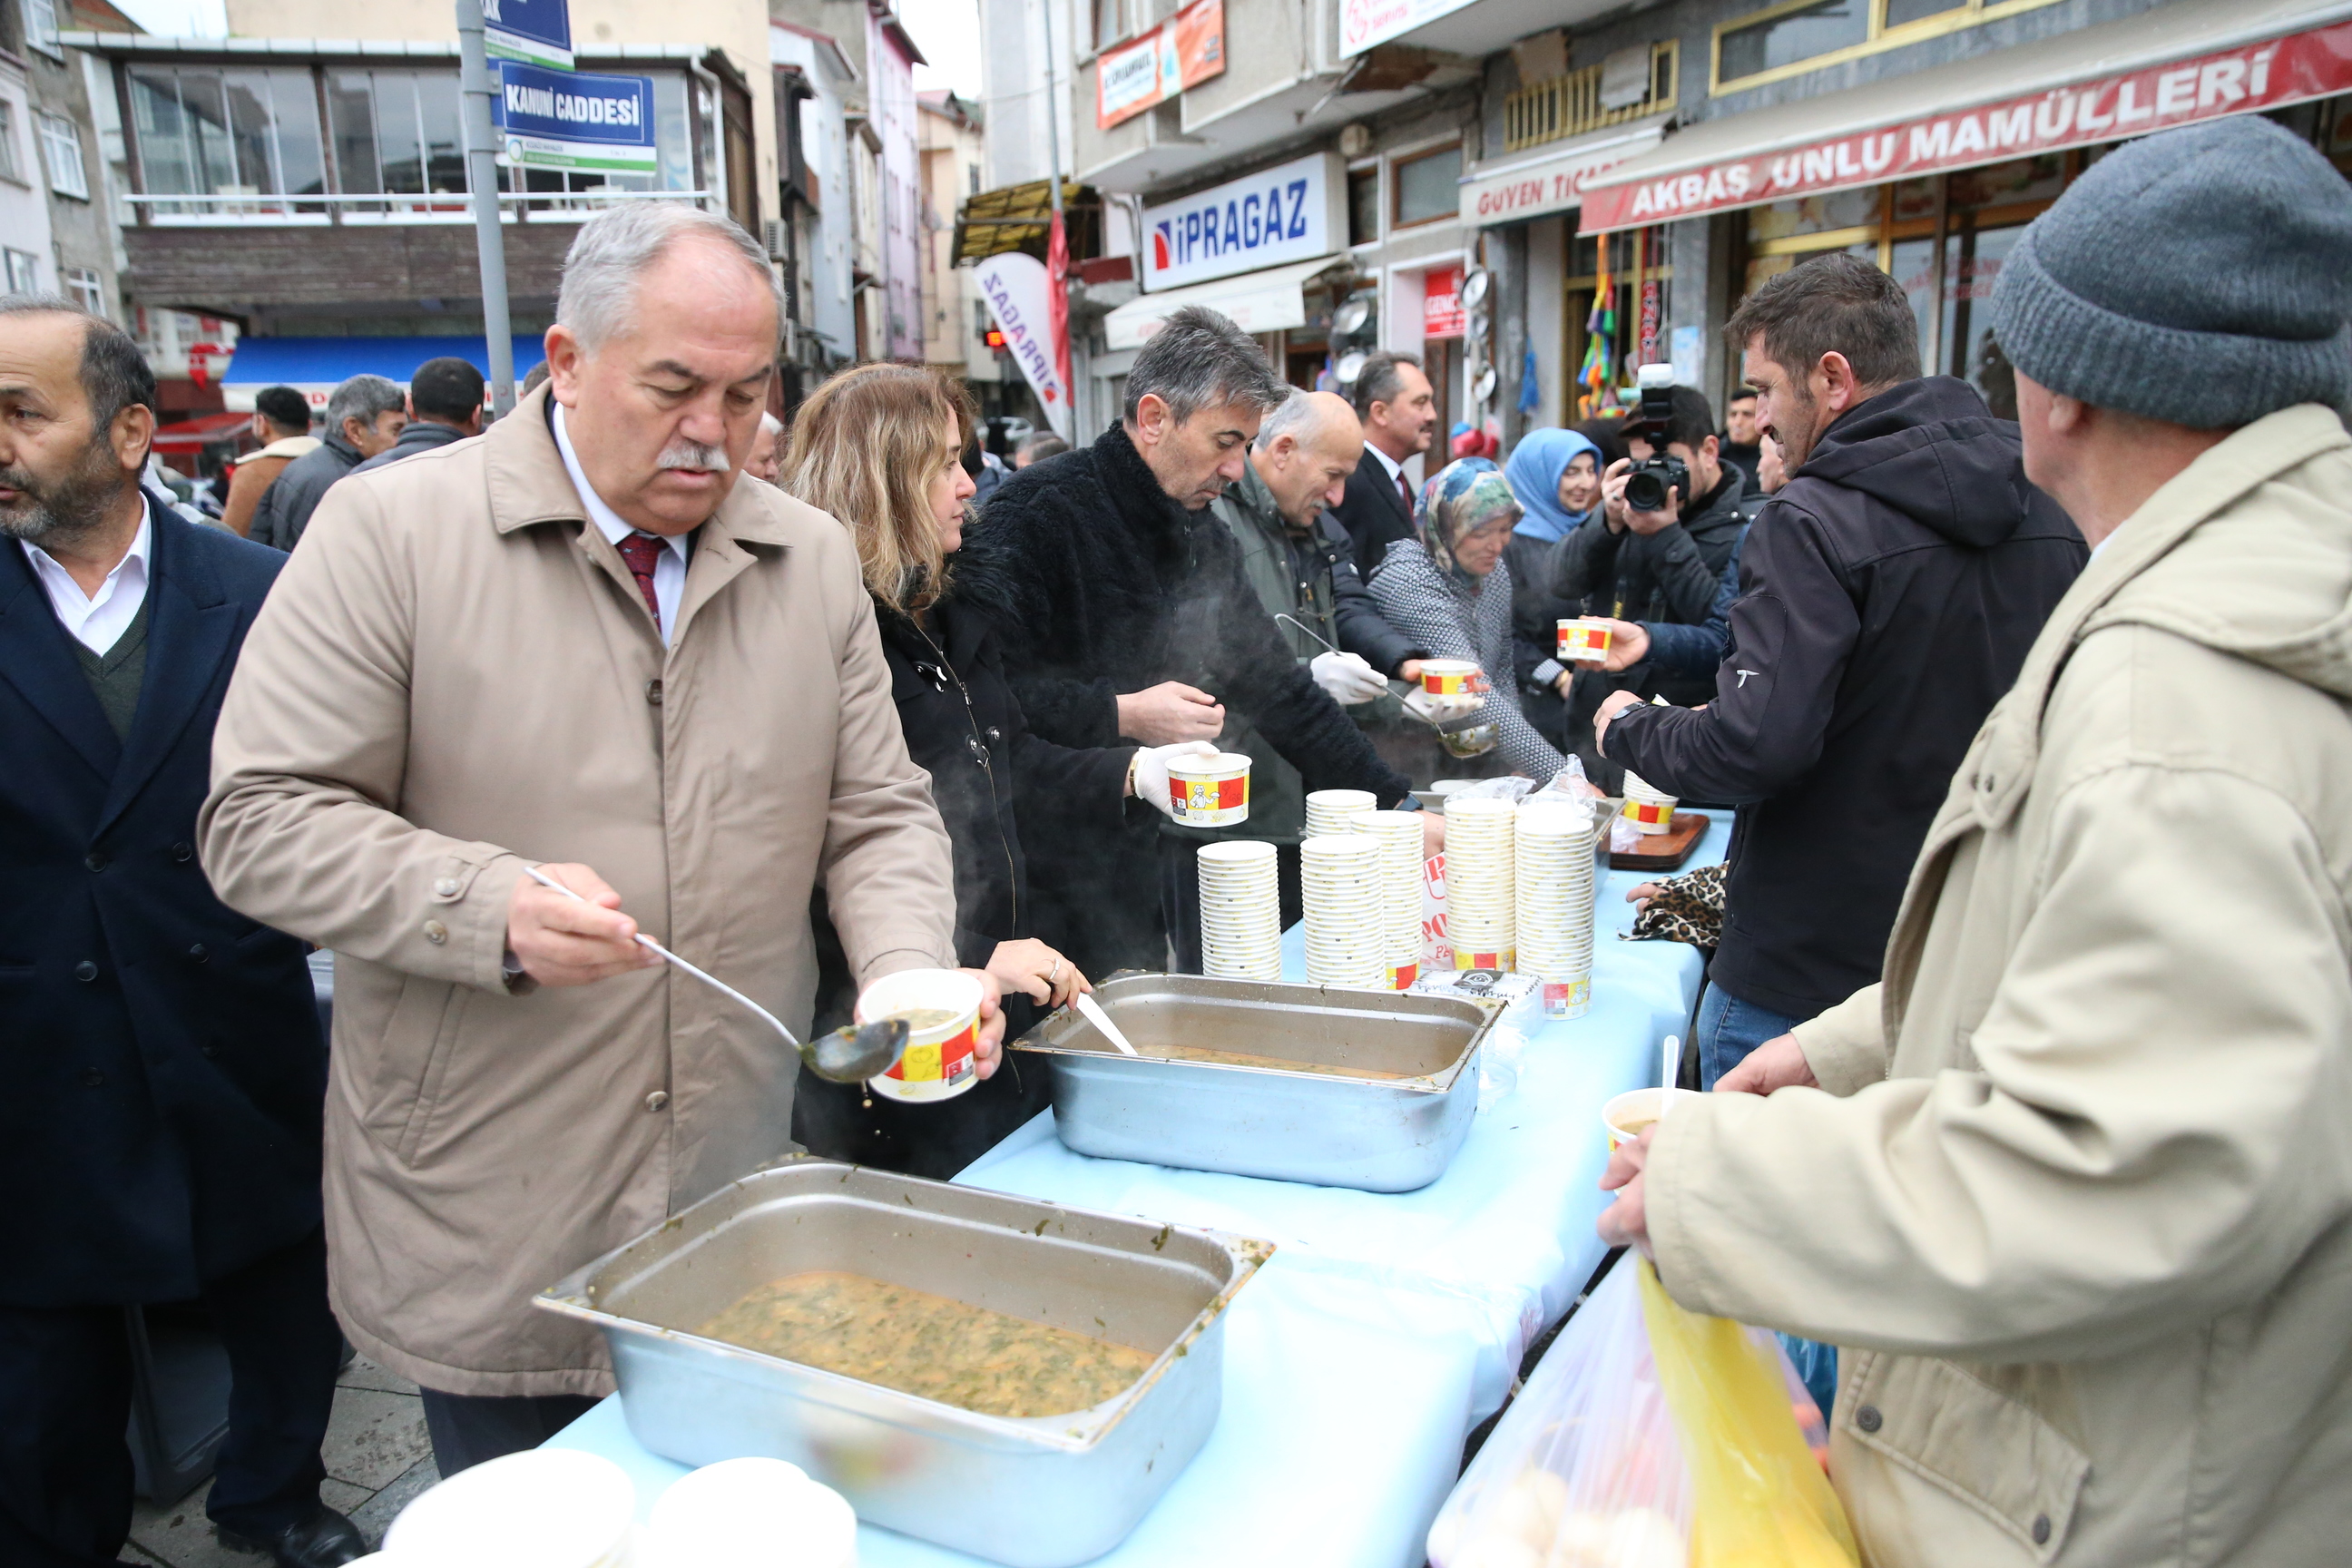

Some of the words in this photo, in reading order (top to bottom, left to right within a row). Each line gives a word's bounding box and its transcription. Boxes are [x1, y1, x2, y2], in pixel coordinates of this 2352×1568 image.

[505, 83, 555, 119] KANUNİ
[554, 93, 640, 126] CADDESİ
[1631, 163, 1751, 217] AKBAŞ
[1771, 132, 1896, 188] UNLU
[1908, 49, 2271, 162] MAMÜLLERİ
